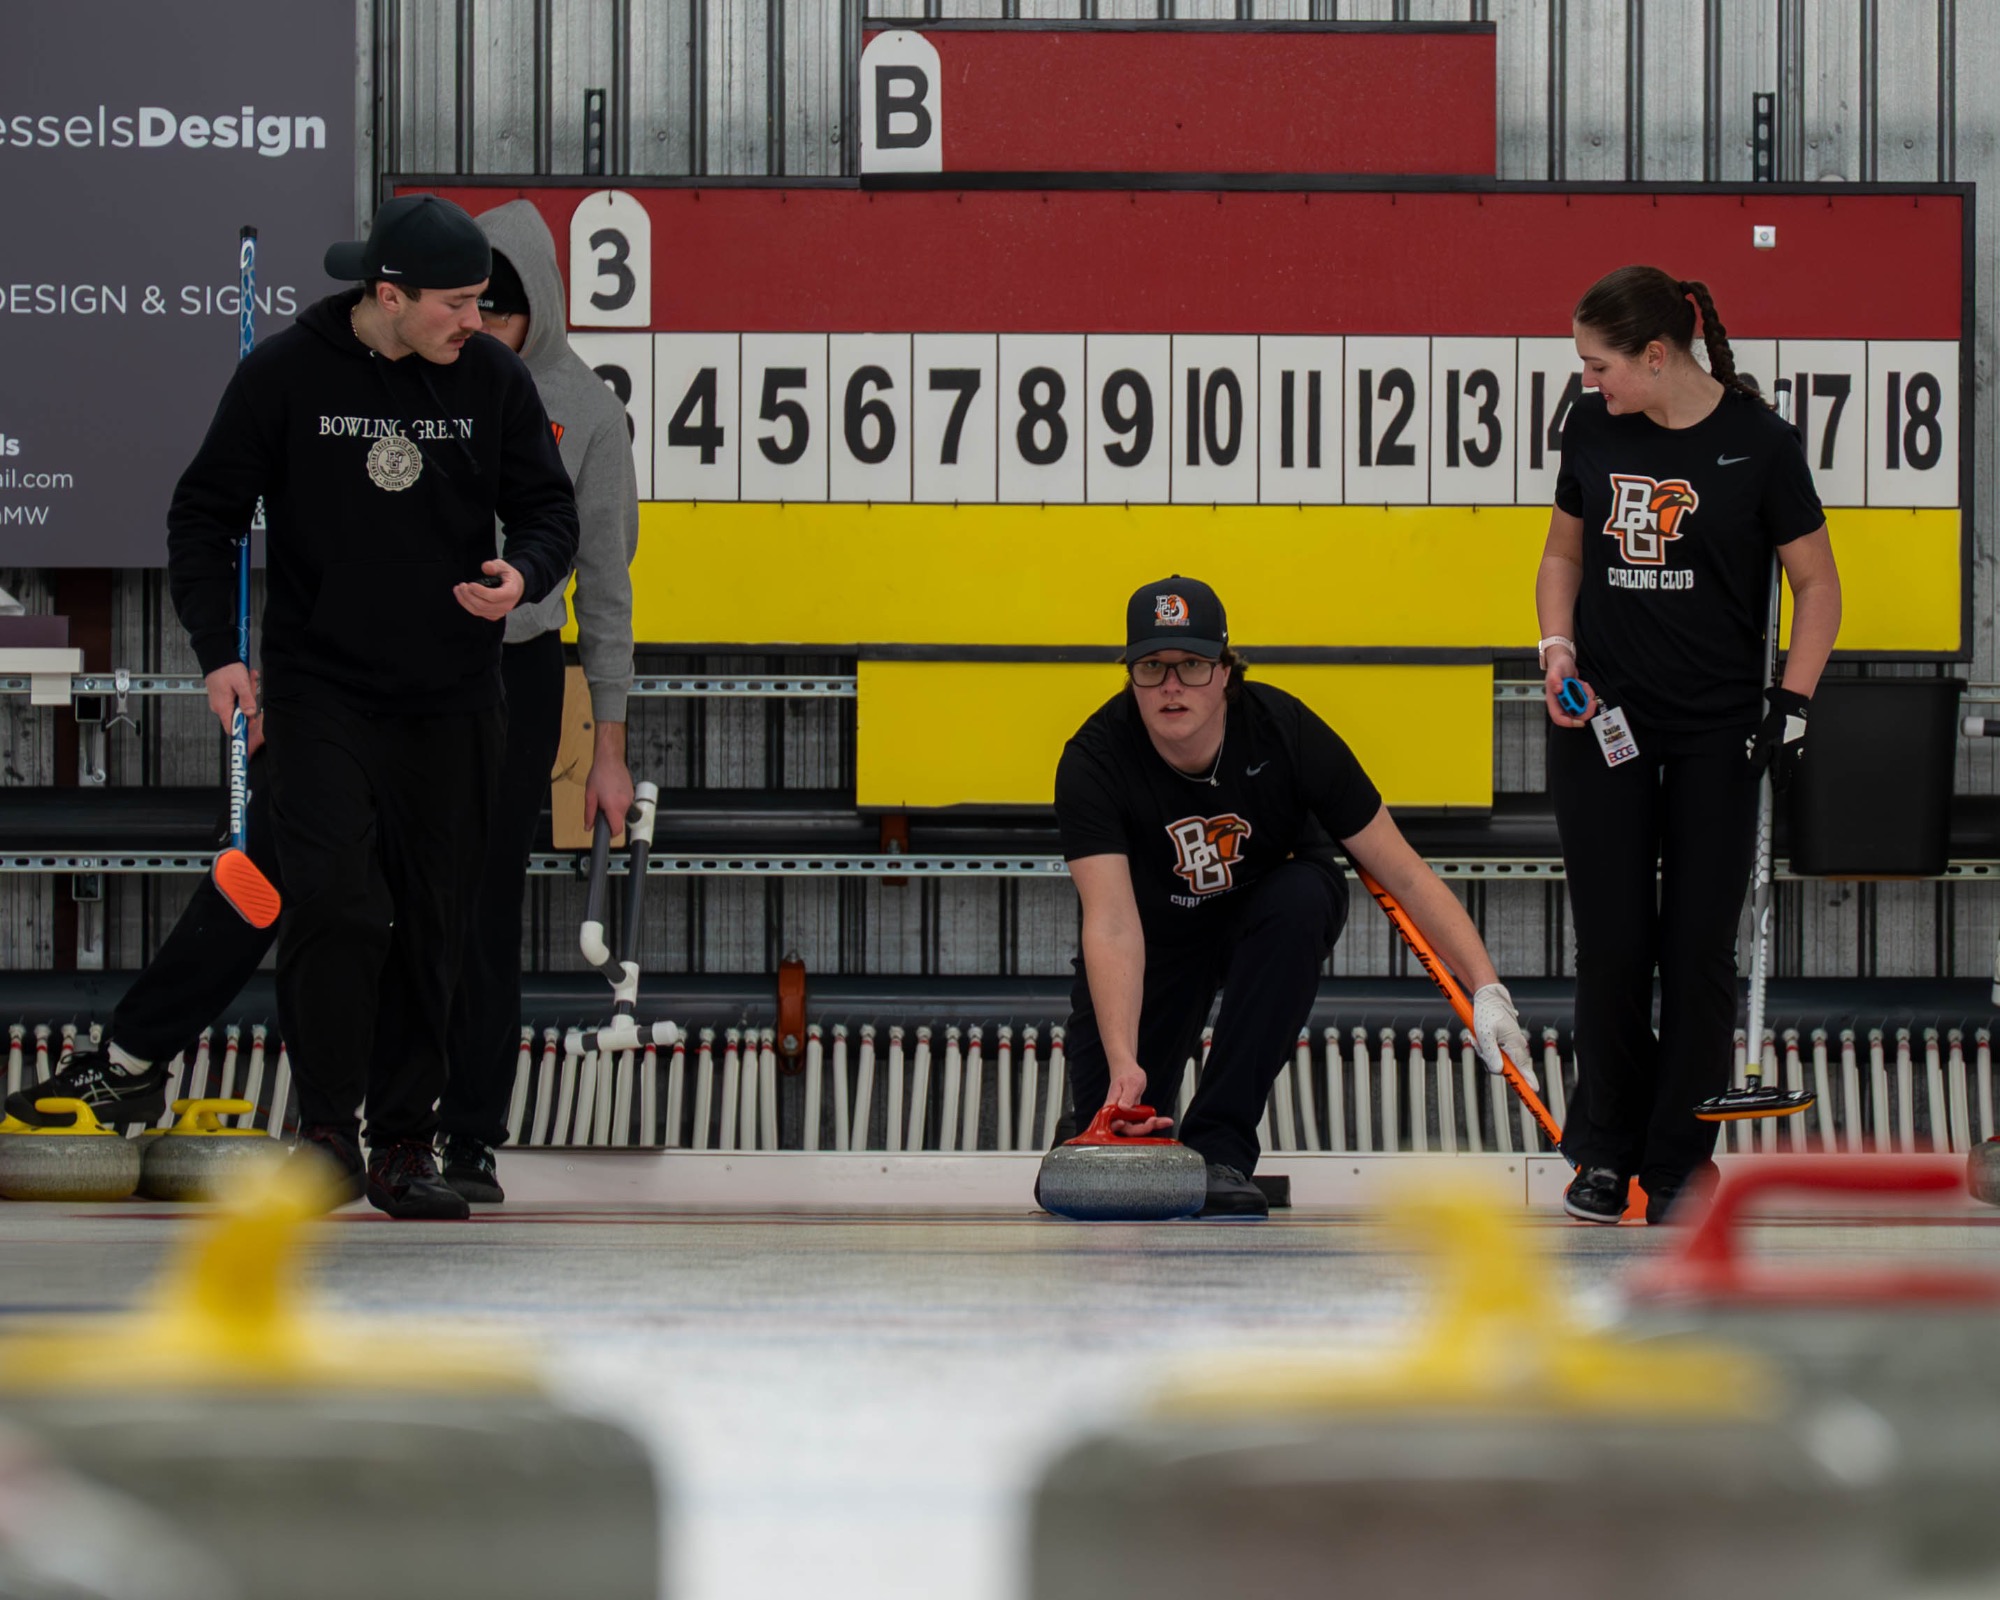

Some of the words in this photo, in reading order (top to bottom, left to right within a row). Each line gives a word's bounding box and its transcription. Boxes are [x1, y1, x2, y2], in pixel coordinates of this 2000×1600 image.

[0, 104, 326, 157] sselsDesign
[875, 65, 932, 149] B
[589, 228, 636, 311] 3
[0, 284, 127, 314] ESIGN
[141, 285, 166, 315] &
[319, 416, 405, 438] BOWLING
[667, 367, 724, 465] 4
[757, 367, 810, 465] 5
[843, 365, 896, 465] 6
[929, 368, 981, 465] 7
[1016, 366, 1068, 466] 8
[1102, 368, 1154, 468] 9
[1186, 367, 1243, 467] 10
[1280, 370, 1321, 469] 11
[1358, 367, 1416, 467] 12
[1446, 368, 1502, 468] 13
[1795, 372, 1851, 470] 17
[1886, 371, 1942, 471] 18
[0, 506, 49, 525] MW
[1660, 570, 1694, 590] CLUB
[230, 738, 247, 834] Goldline
